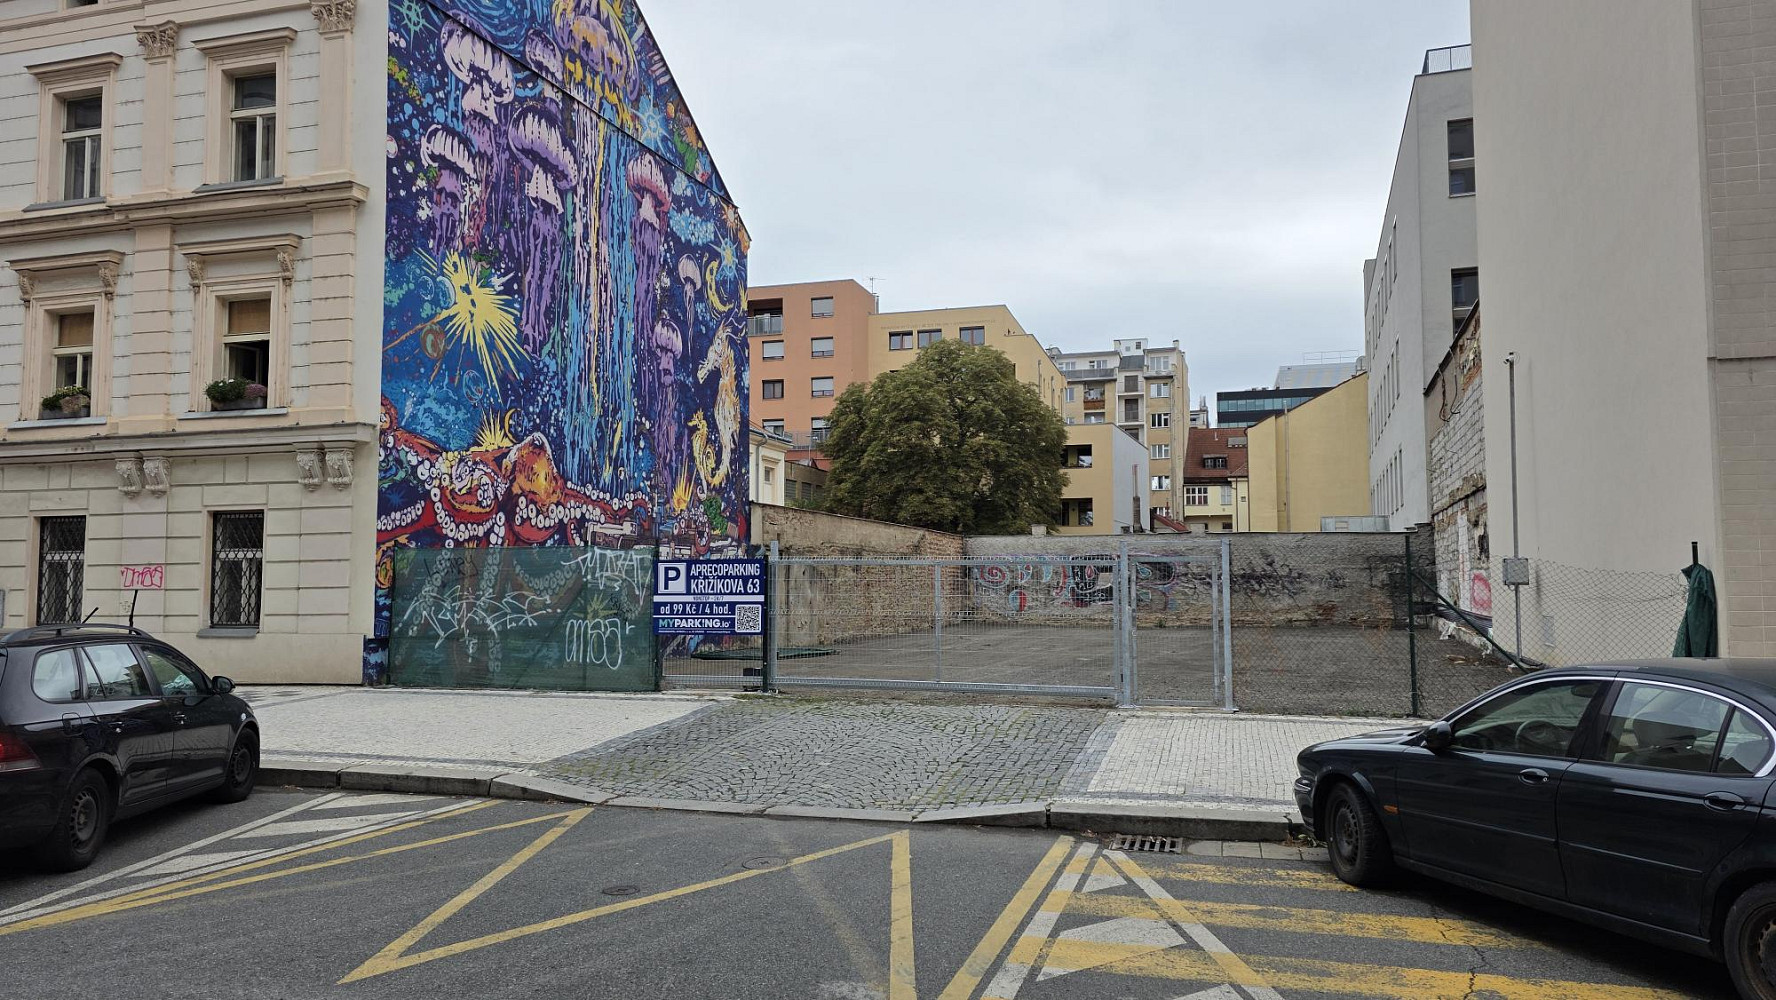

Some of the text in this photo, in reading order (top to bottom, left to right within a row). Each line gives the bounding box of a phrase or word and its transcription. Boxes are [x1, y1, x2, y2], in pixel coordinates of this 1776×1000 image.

[690, 563, 760, 576] APRECOPARKING
[664, 566, 681, 591] P
[691, 576, 760, 593] KŘIŽÍKOVA 63
[660, 603, 732, 614] od 99 Kč / 4 hod.
